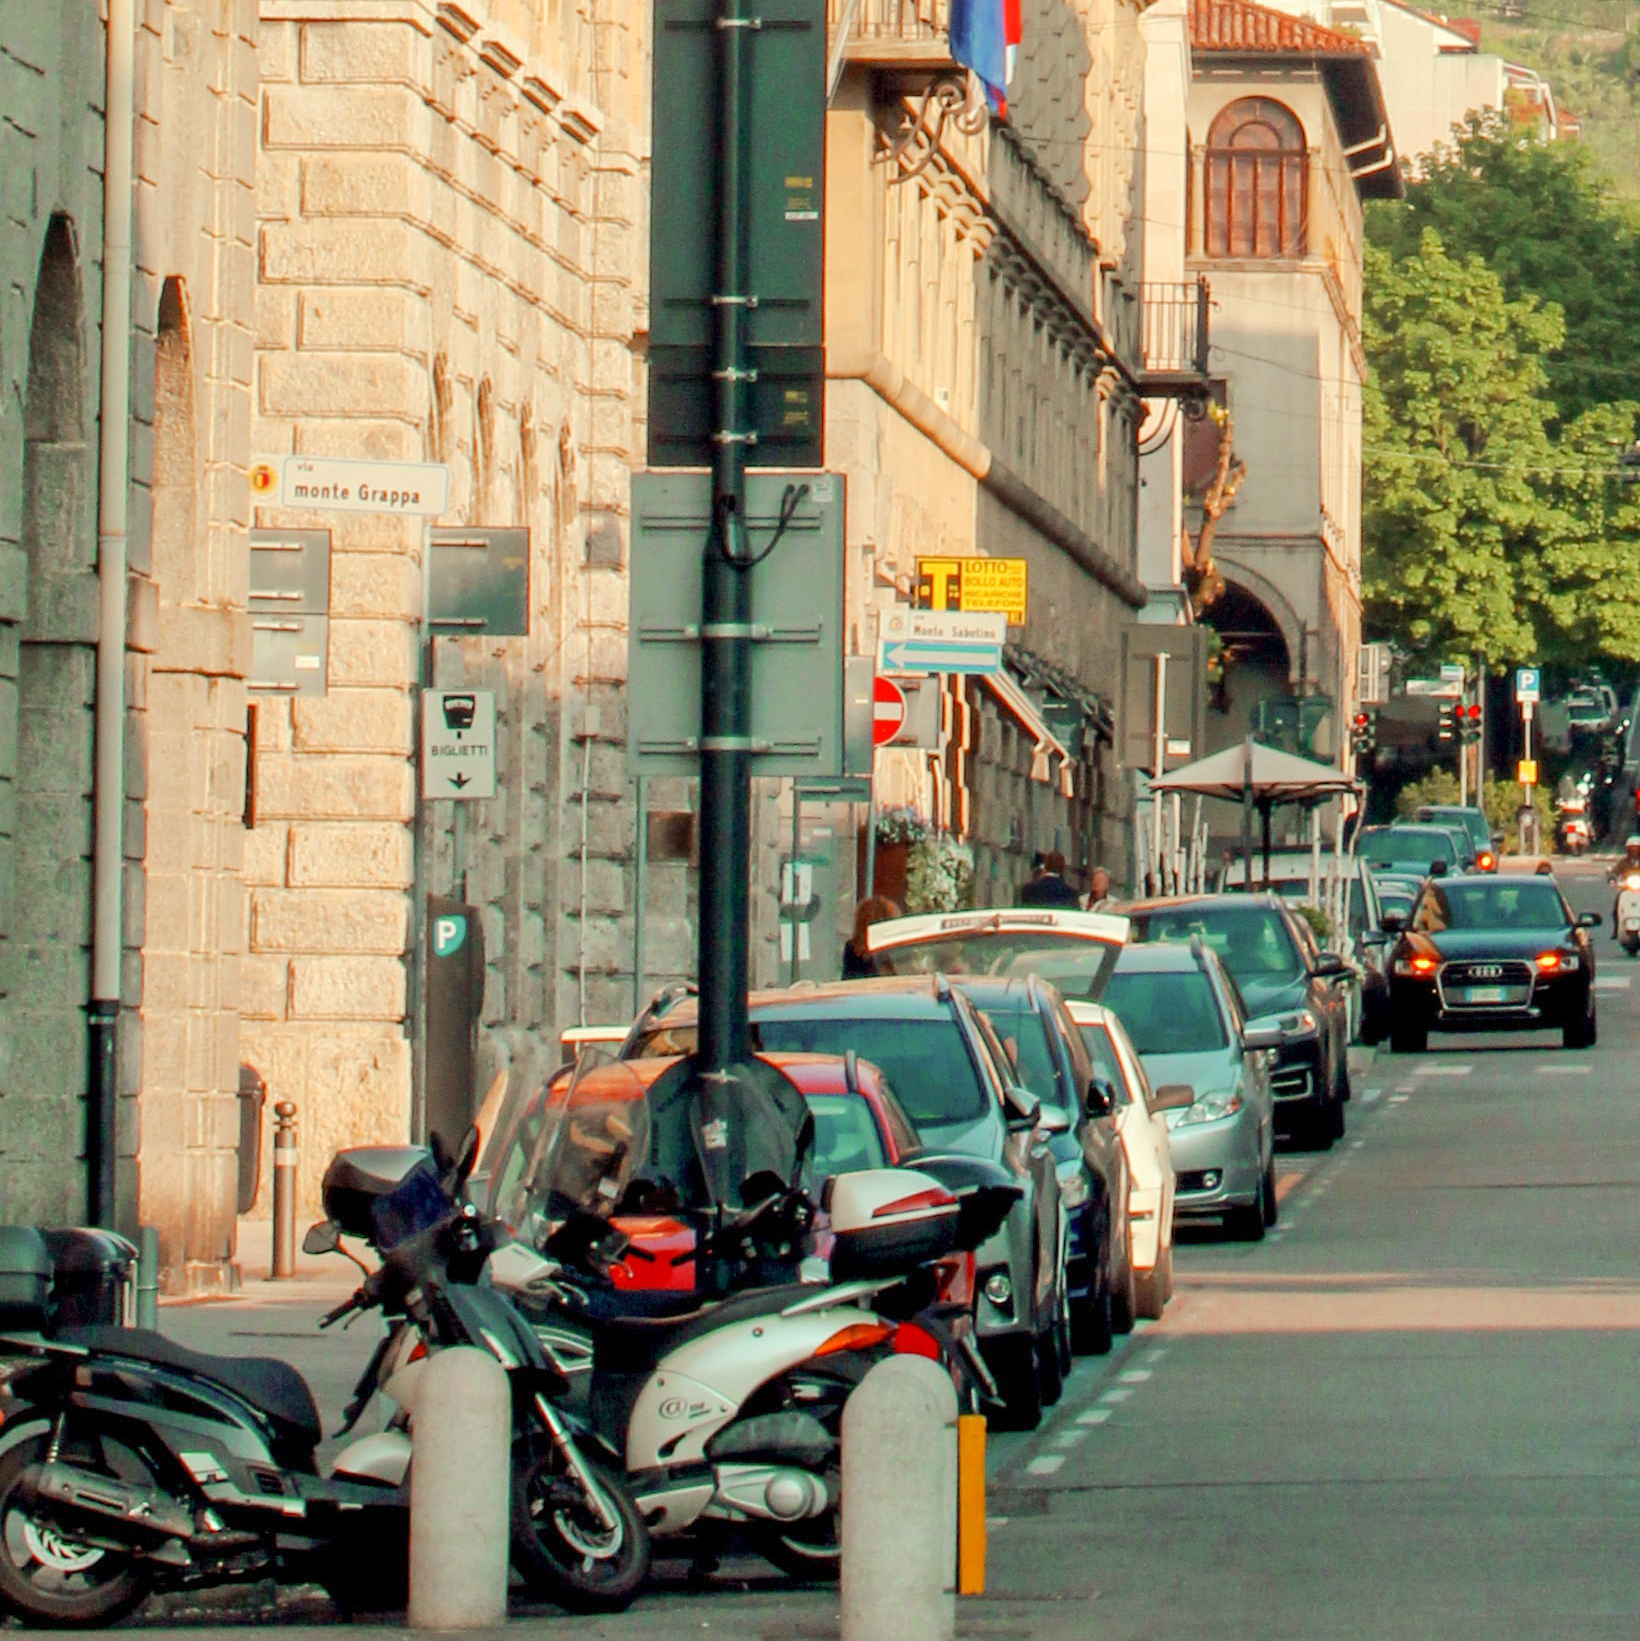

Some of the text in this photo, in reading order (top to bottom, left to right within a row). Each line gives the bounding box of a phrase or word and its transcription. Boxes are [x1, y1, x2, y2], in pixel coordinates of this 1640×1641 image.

[297, 463, 314, 472] via
[294, 482, 421, 507] monte Grappa
[965, 561, 1007, 574] LOTTO
[964, 576, 1023, 588] BOLLO AUTO
[913, 624, 945, 637] Monte
[431, 745, 488, 756] BIGLIETTI
[437, 919, 457, 949] P
